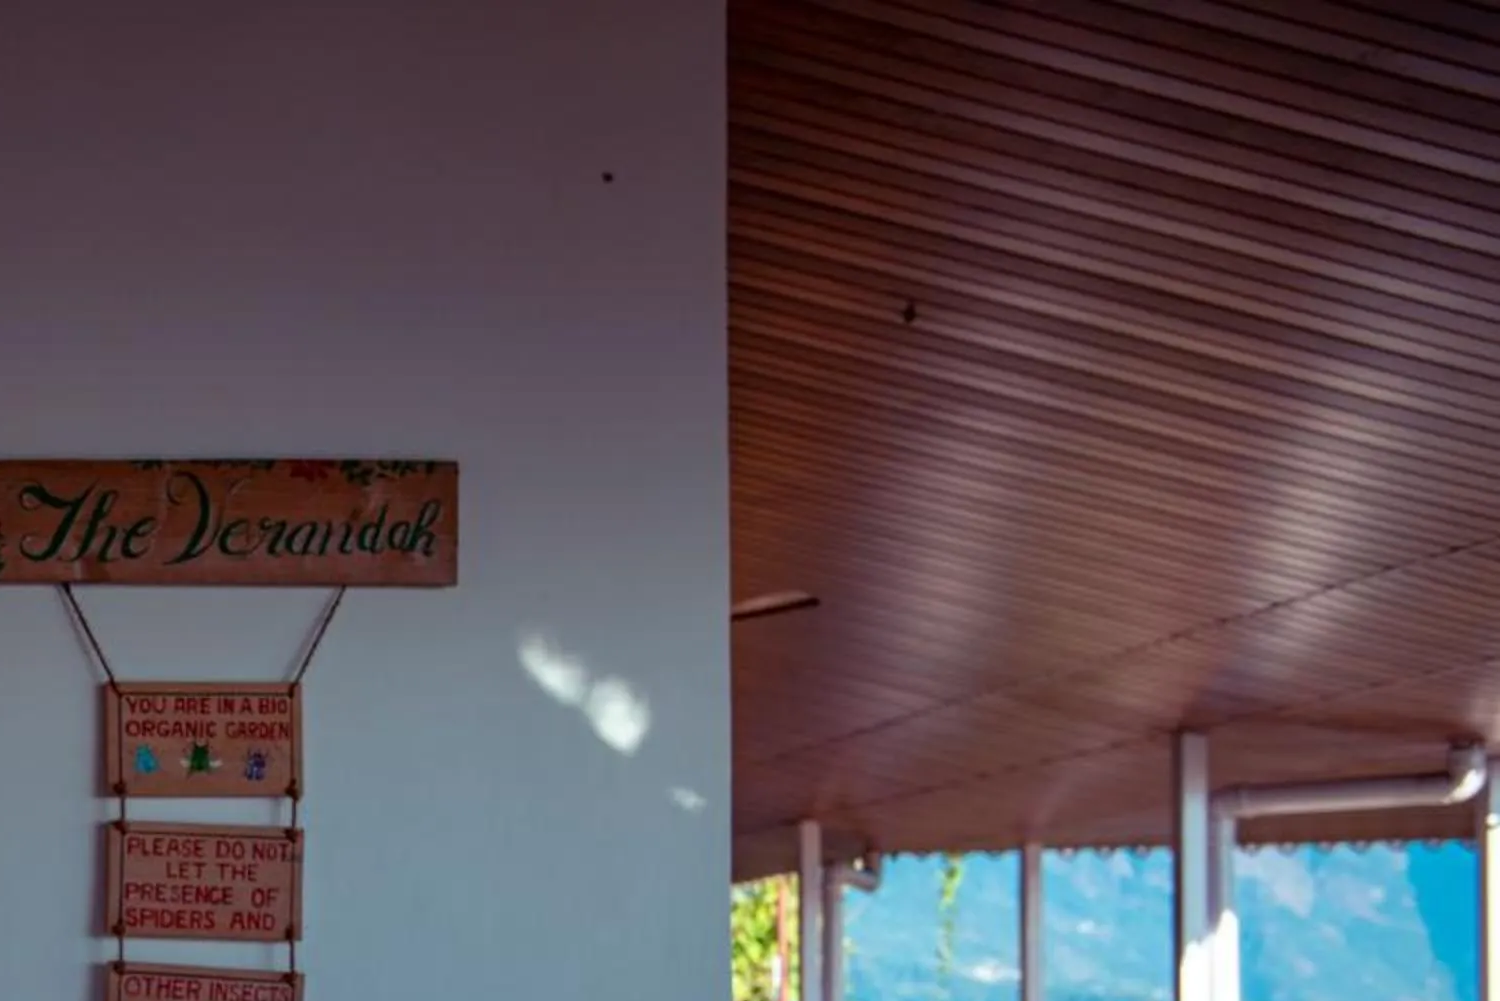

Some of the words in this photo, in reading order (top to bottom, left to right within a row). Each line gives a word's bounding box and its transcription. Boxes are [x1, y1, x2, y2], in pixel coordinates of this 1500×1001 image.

[18, 481, 156, 562] The
[162, 470, 439, 566] Verandah
[126, 698, 165, 715] YOU
[174, 698, 210, 715] ARE
[217, 698, 235, 715] IN
[241, 699, 253, 715] A
[259, 698, 288, 716] BIO
[125, 720, 217, 739] ORGANIC
[225, 721, 289, 741] GARDEN
[126, 836, 205, 857] PLEASE
[216, 841, 245, 859] DO
[252, 841, 289, 862] NOT
[166, 862, 206, 880] LET
[219, 864, 258, 882] THE
[125, 883, 233, 906] PRESENCE
[252, 888, 280, 909] OF
[126, 908, 215, 930] SPIDERS
[229, 912, 276, 931] AND
[124, 976, 202, 1001] OTHER
